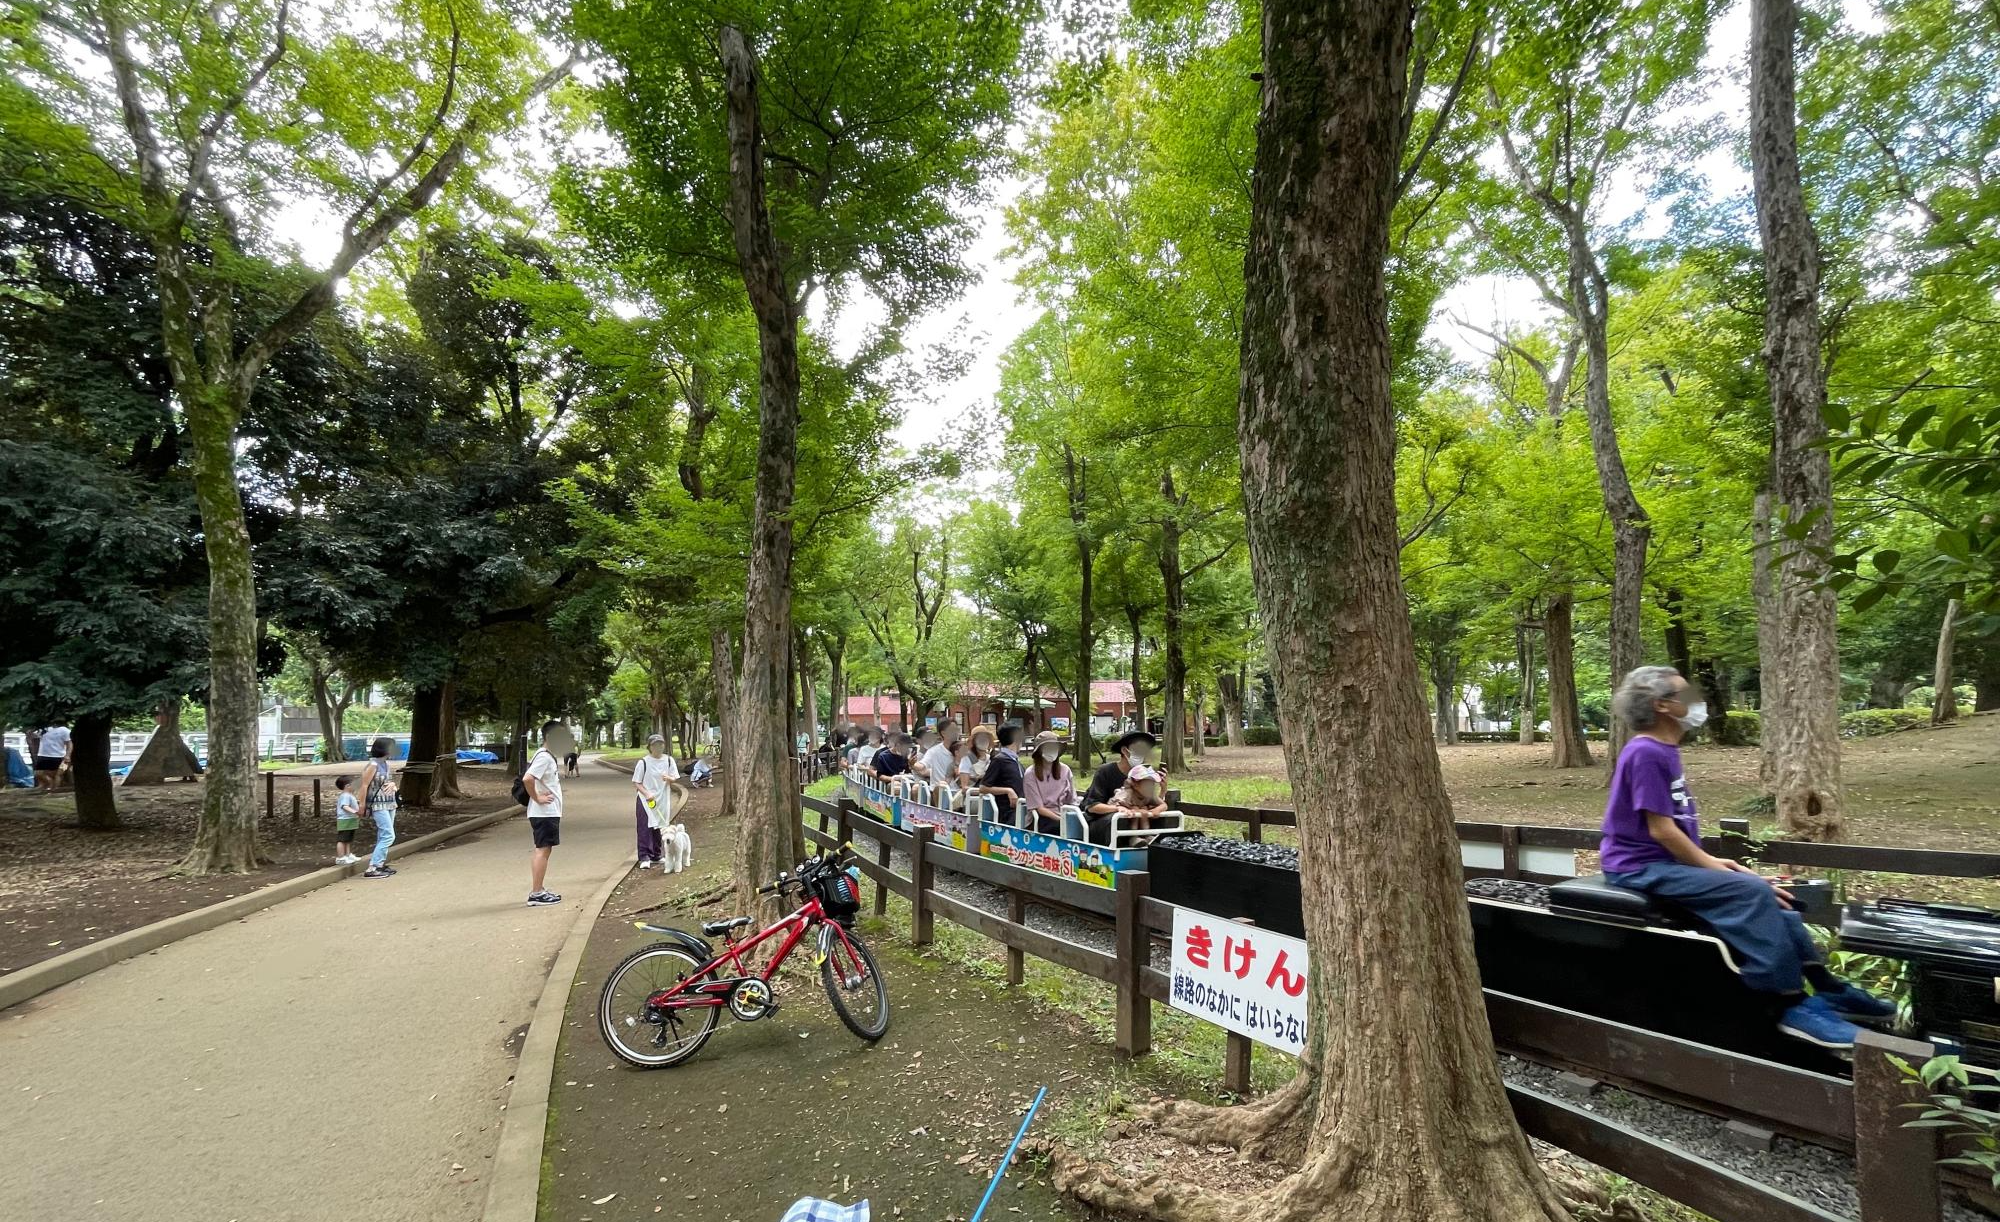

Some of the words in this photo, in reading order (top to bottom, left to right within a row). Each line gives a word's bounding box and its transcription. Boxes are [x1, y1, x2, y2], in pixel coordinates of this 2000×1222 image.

[1063, 860, 1076, 878] SL
[1186, 925, 1306, 997] きけん
[1173, 972, 1241, 1021] 線路のなかに
